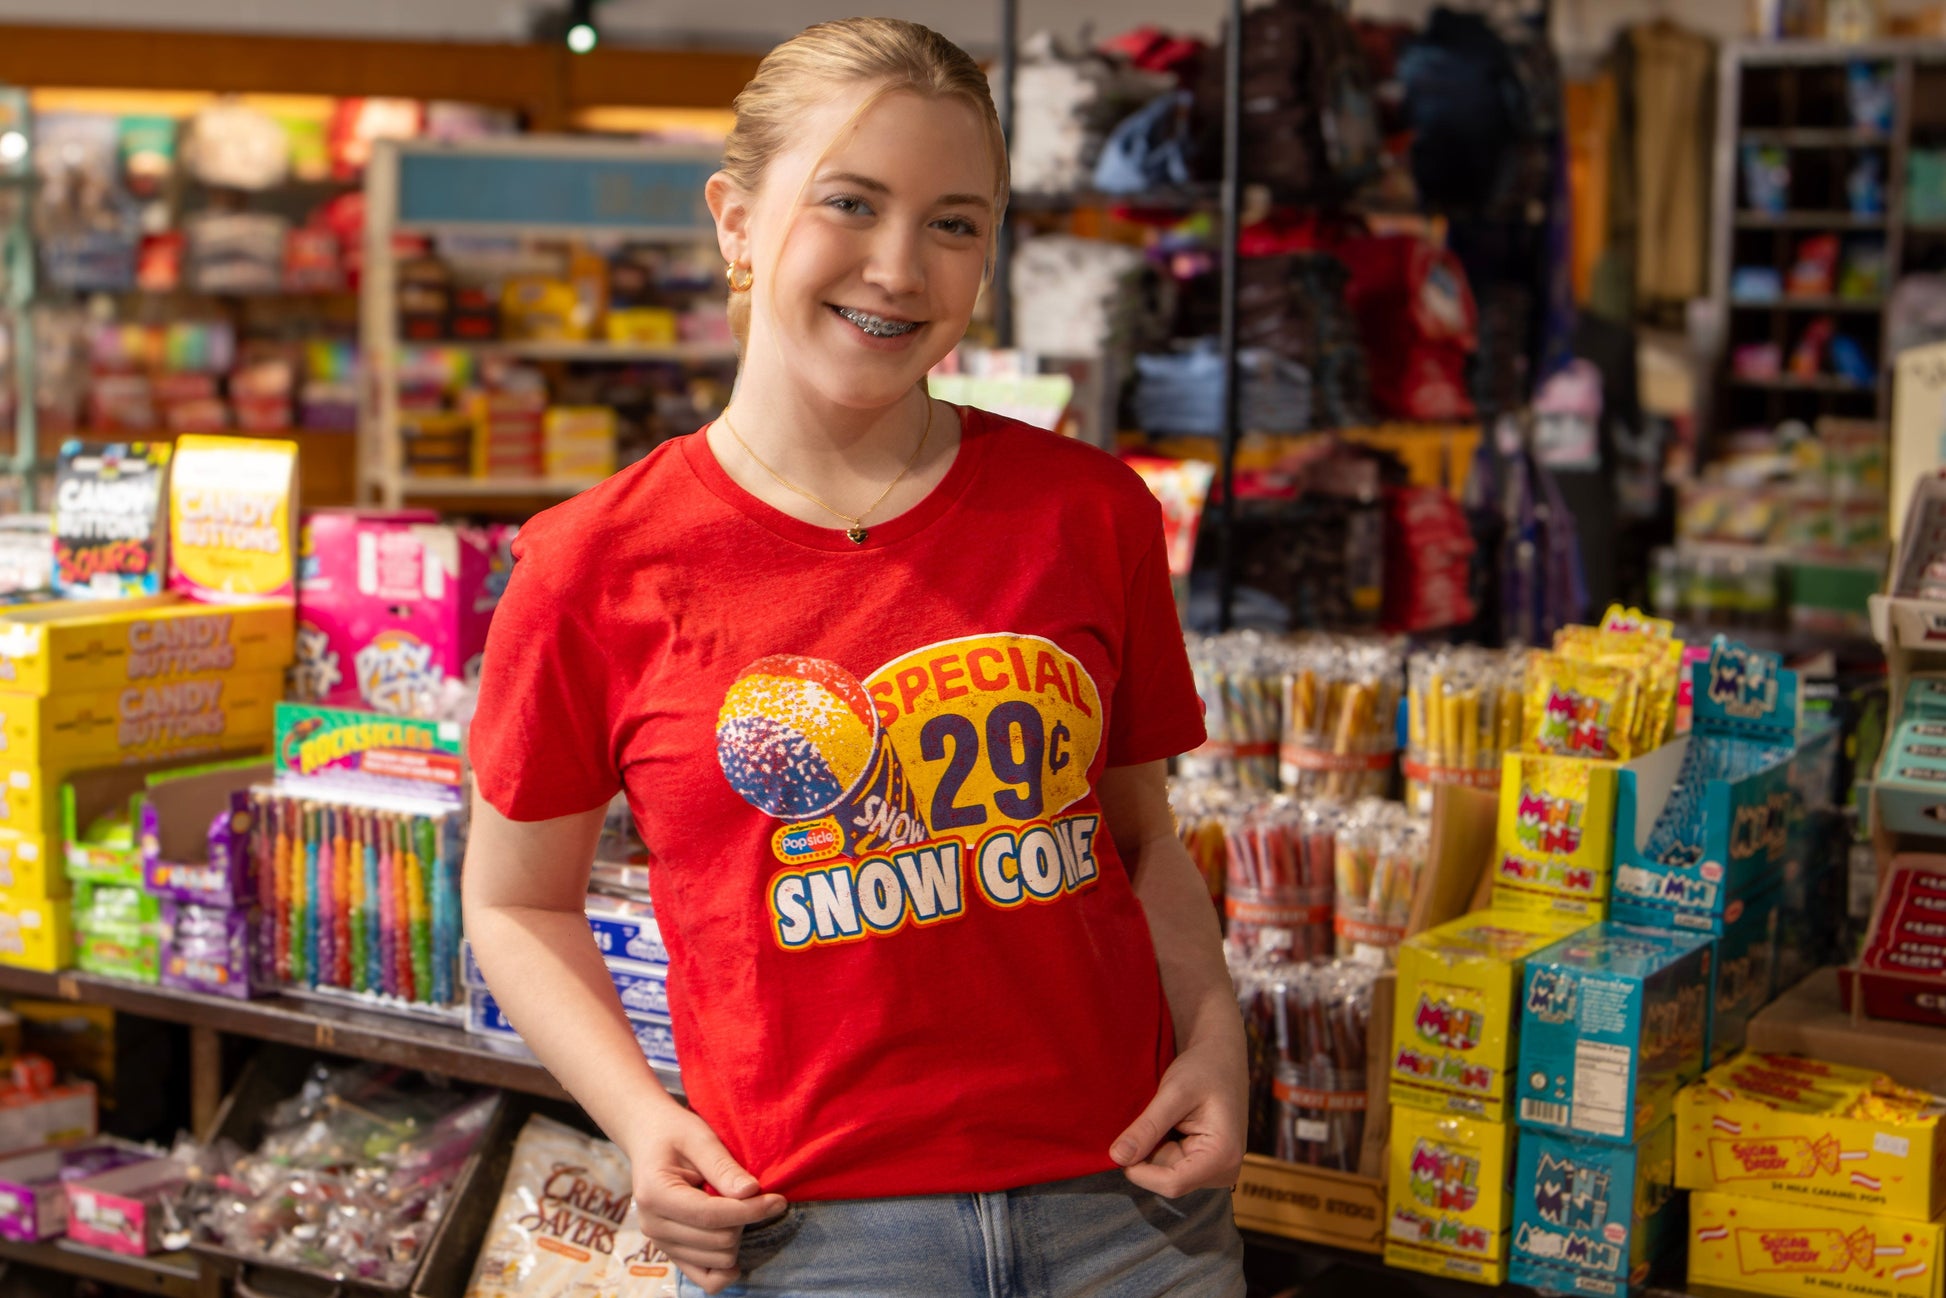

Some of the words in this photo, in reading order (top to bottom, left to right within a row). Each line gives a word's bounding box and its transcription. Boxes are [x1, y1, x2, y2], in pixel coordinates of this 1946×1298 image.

[128, 614, 233, 652] CANDY
[126, 643, 235, 681] BUTTONS
[118, 678, 224, 722] CANDY
[866, 646, 1092, 728] SPECIAL
[118, 709, 225, 747] BUTTONS
[853, 795, 925, 844] SNOW
[781, 830, 835, 851] Popsicle
[773, 840, 963, 948] SNOW
[979, 816, 1098, 903] CONE
[543, 1162, 633, 1226] CREM
[1786, 1183, 1810, 1195] MILK
[1812, 1186, 1856, 1200] CARAMEL
[1859, 1192, 1887, 1205] POPS
[518, 1195, 617, 1256] SAVERS
[1820, 1278, 1843, 1291] MILK
[1846, 1282, 1895, 1298] CARAMEL
